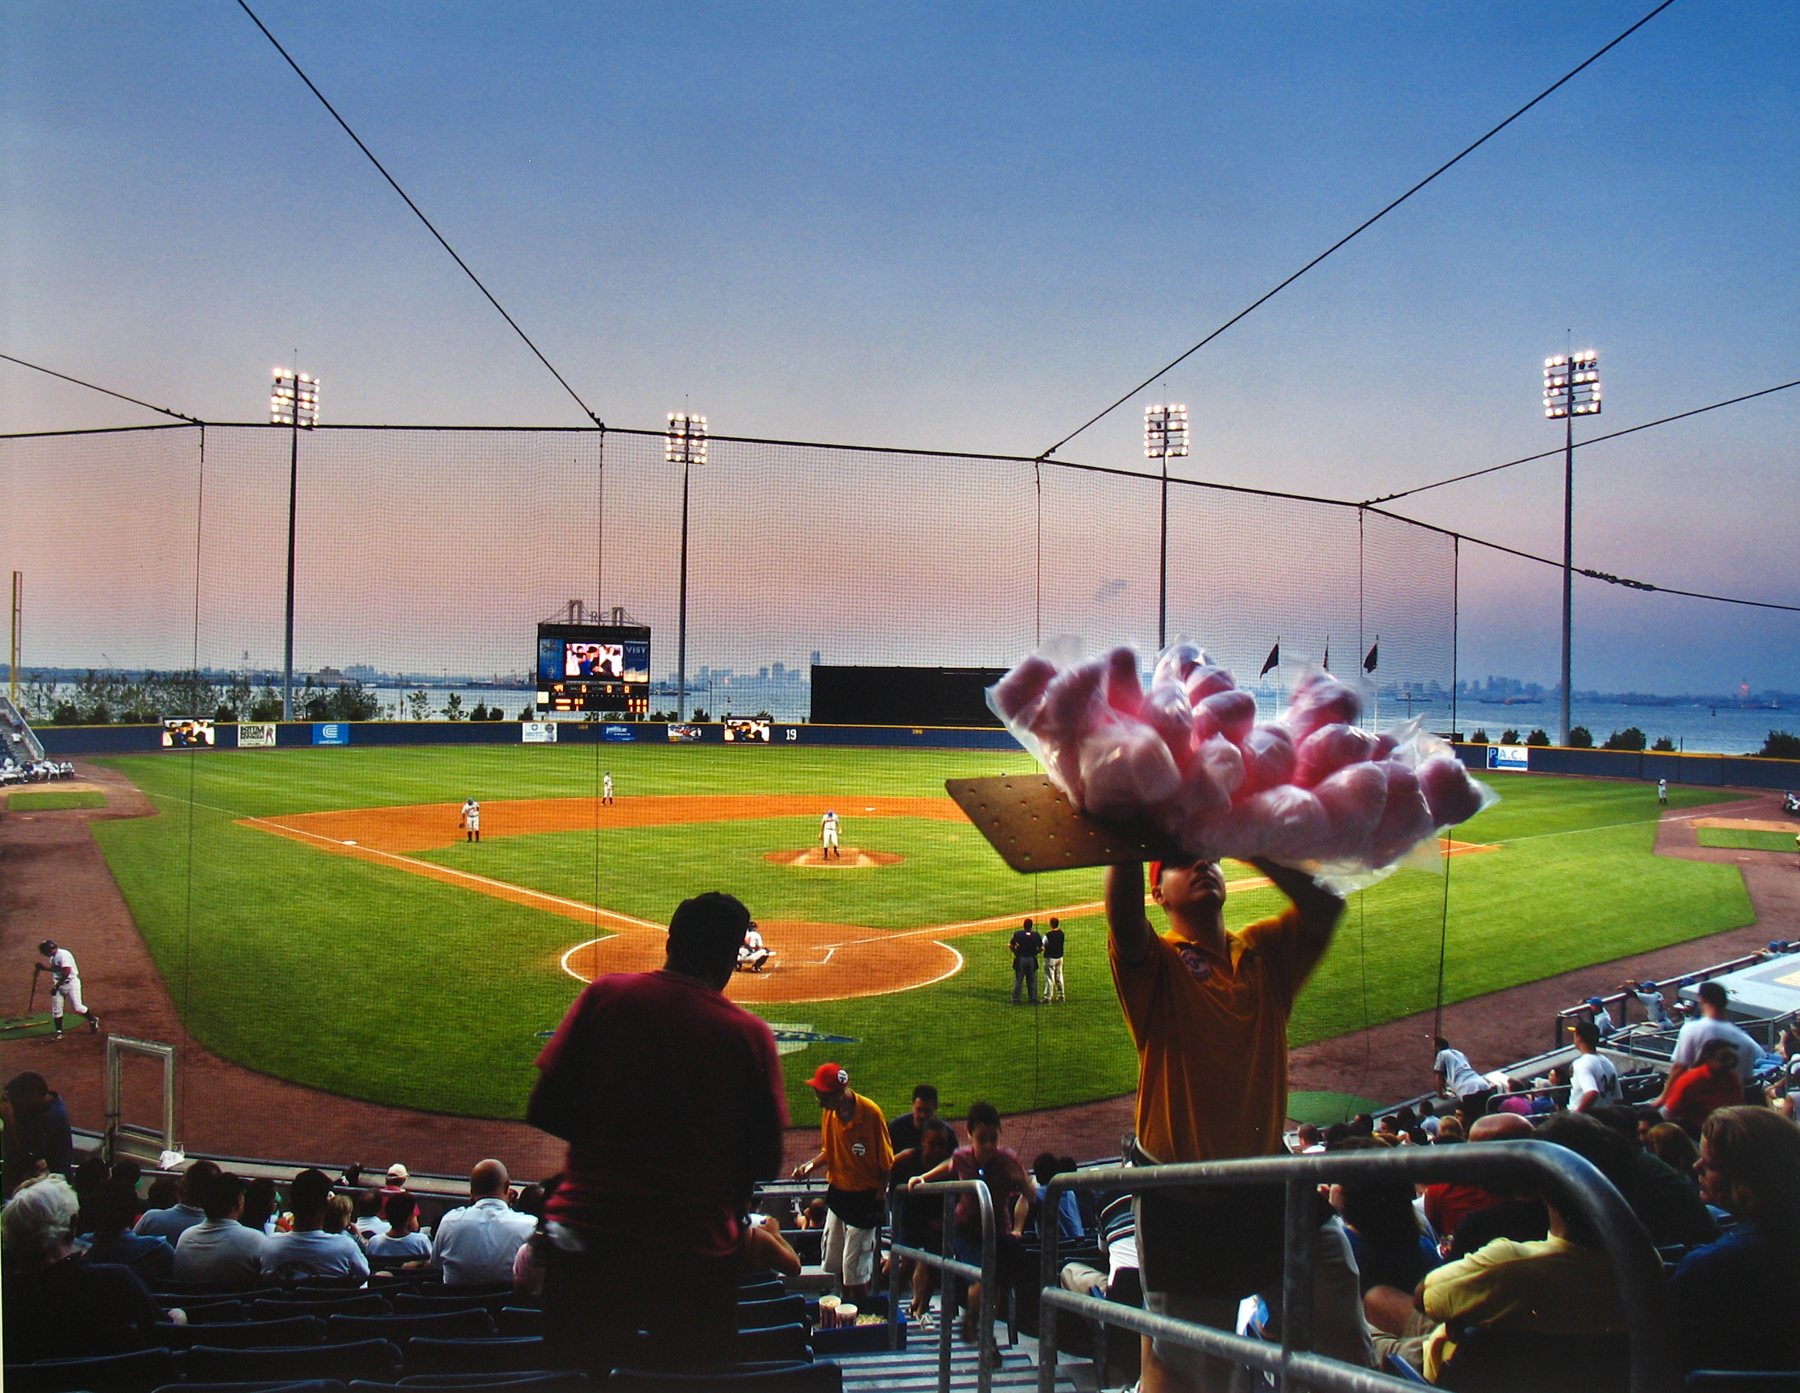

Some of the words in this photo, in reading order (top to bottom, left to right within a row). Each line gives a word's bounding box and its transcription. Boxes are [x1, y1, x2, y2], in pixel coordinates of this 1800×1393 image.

[626, 646, 647, 654] VISY
[785, 728, 797, 740] 19
[1489, 748, 1522, 760] P.A.C.
